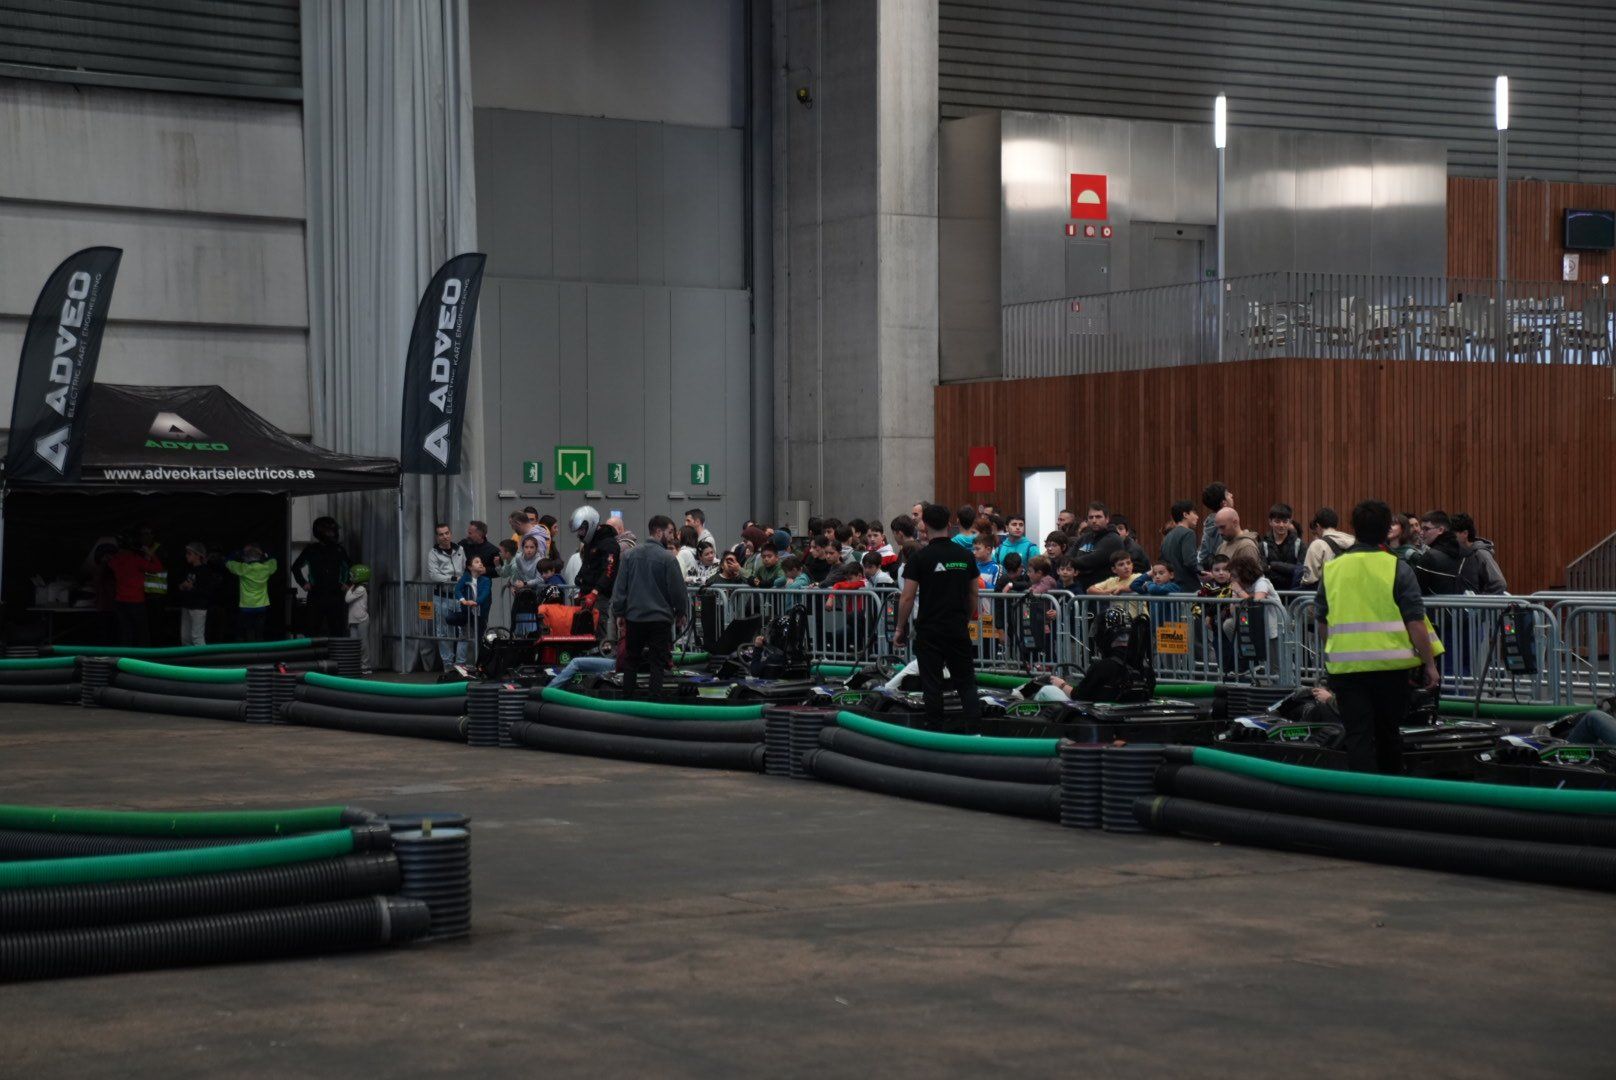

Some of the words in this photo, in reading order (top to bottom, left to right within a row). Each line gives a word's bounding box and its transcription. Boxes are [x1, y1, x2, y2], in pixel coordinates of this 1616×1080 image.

[45, 271, 91, 417] ADVEO
[429, 278, 462, 414] ADVEO
[453, 340, 461, 366] KART
[67, 370, 83, 417] ELECTRIC
[77, 340, 88, 368] KART
[144, 439, 230, 452] ADVEO
[104, 467, 315, 480] www.adveokartselectricos.es
